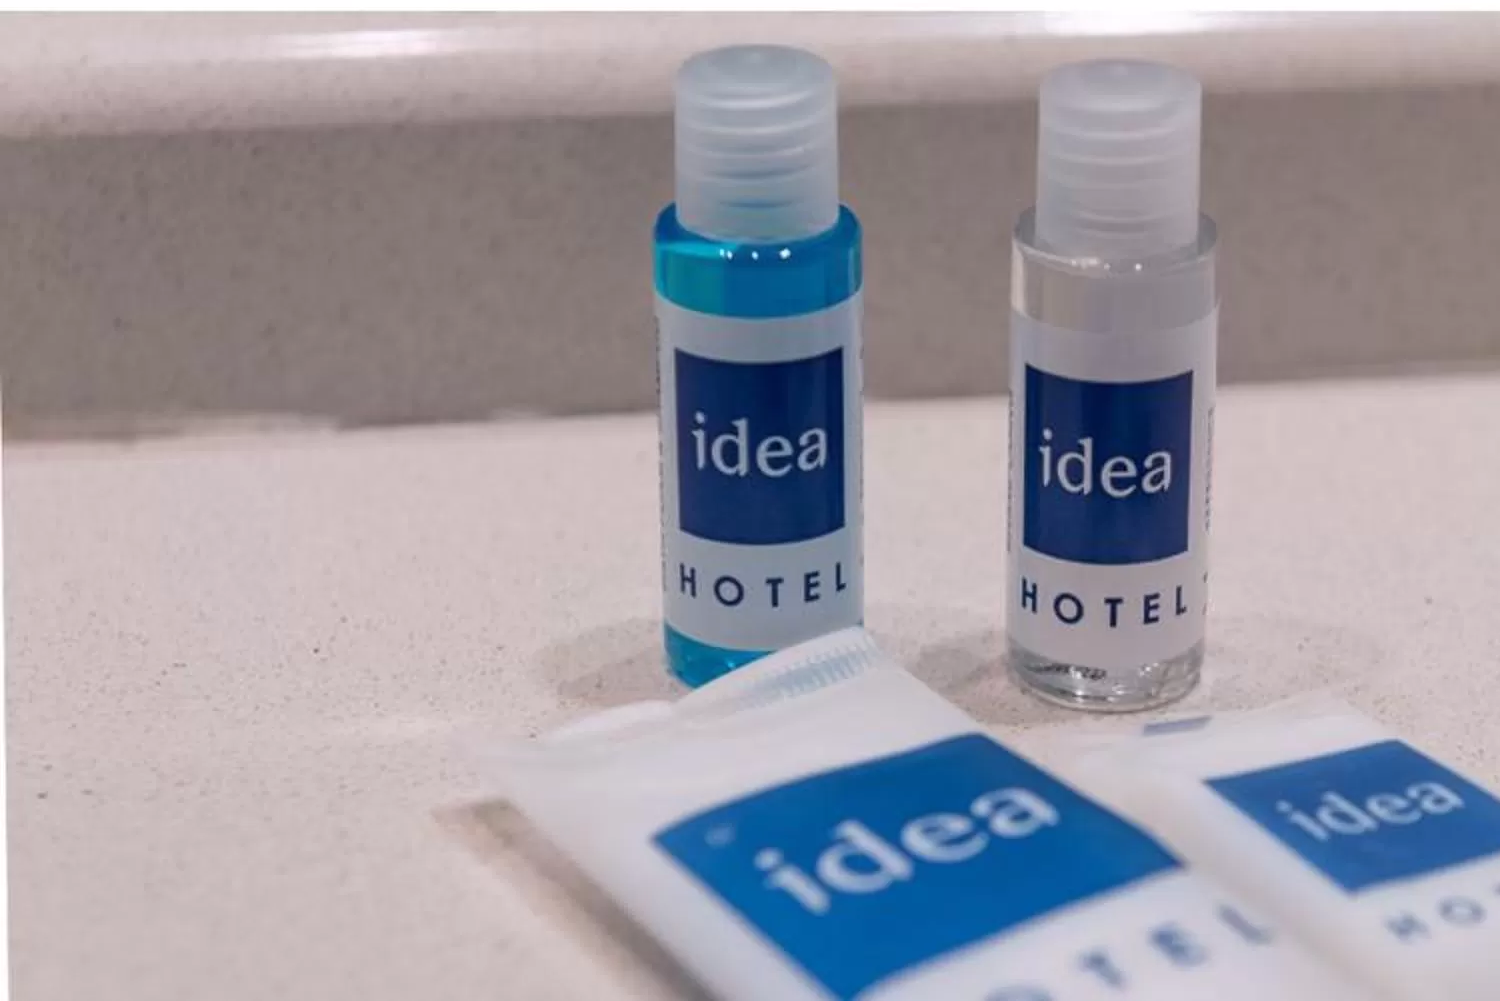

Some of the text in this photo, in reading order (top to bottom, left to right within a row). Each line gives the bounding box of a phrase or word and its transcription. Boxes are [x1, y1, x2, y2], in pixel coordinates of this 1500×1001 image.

[692, 412, 828, 477] idea
[1039, 429, 1173, 497] idea
[680, 562, 847, 608] HOTEL
[1020, 577, 1188, 628] HOTEL
[1276, 782, 1465, 841] idea
[754, 787, 1060, 915] idea
